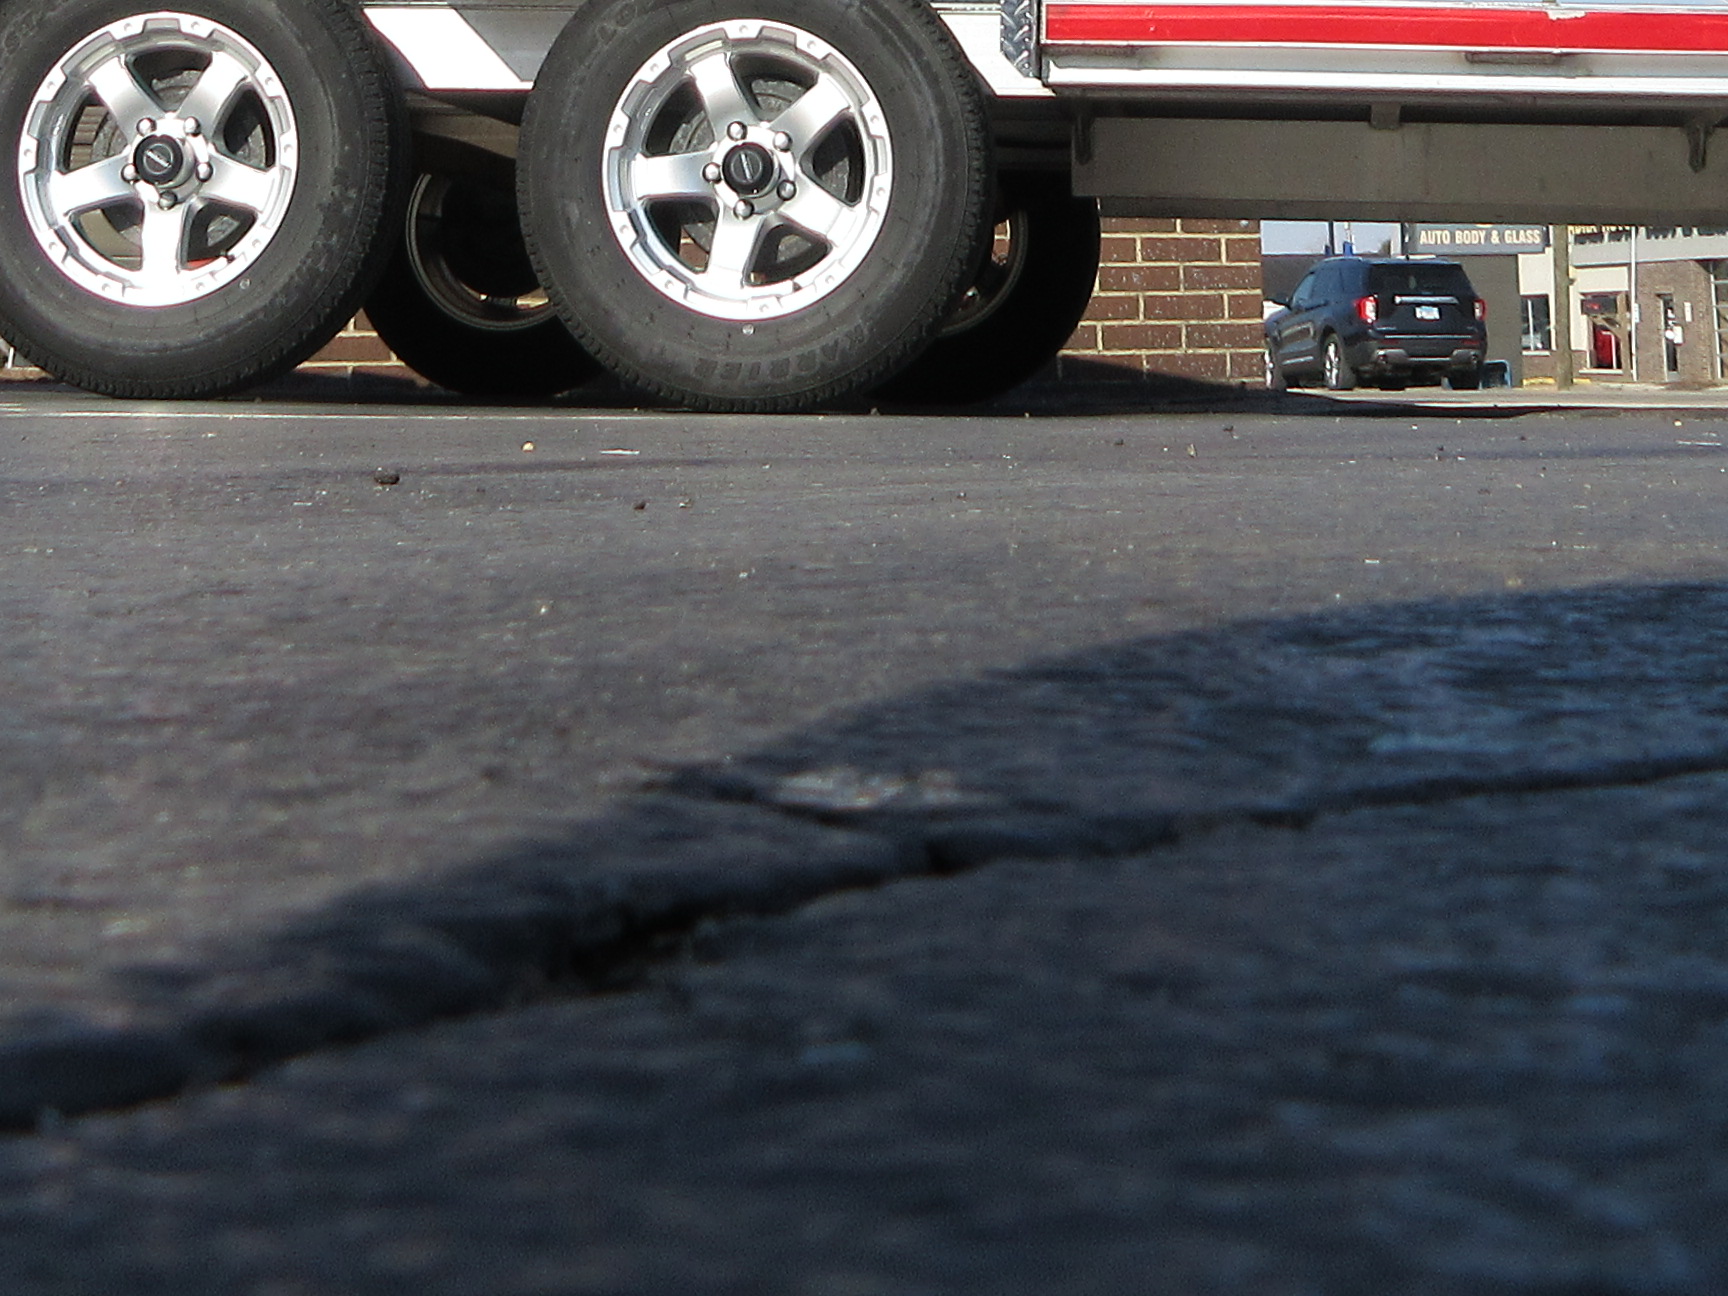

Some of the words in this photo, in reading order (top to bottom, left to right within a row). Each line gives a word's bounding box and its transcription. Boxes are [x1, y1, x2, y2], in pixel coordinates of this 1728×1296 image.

[1420, 230, 1450, 245] AUTO
[1455, 230, 1486, 245] BODY
[1491, 229, 1501, 244] &
[1504, 229, 1541, 244] GLASS
